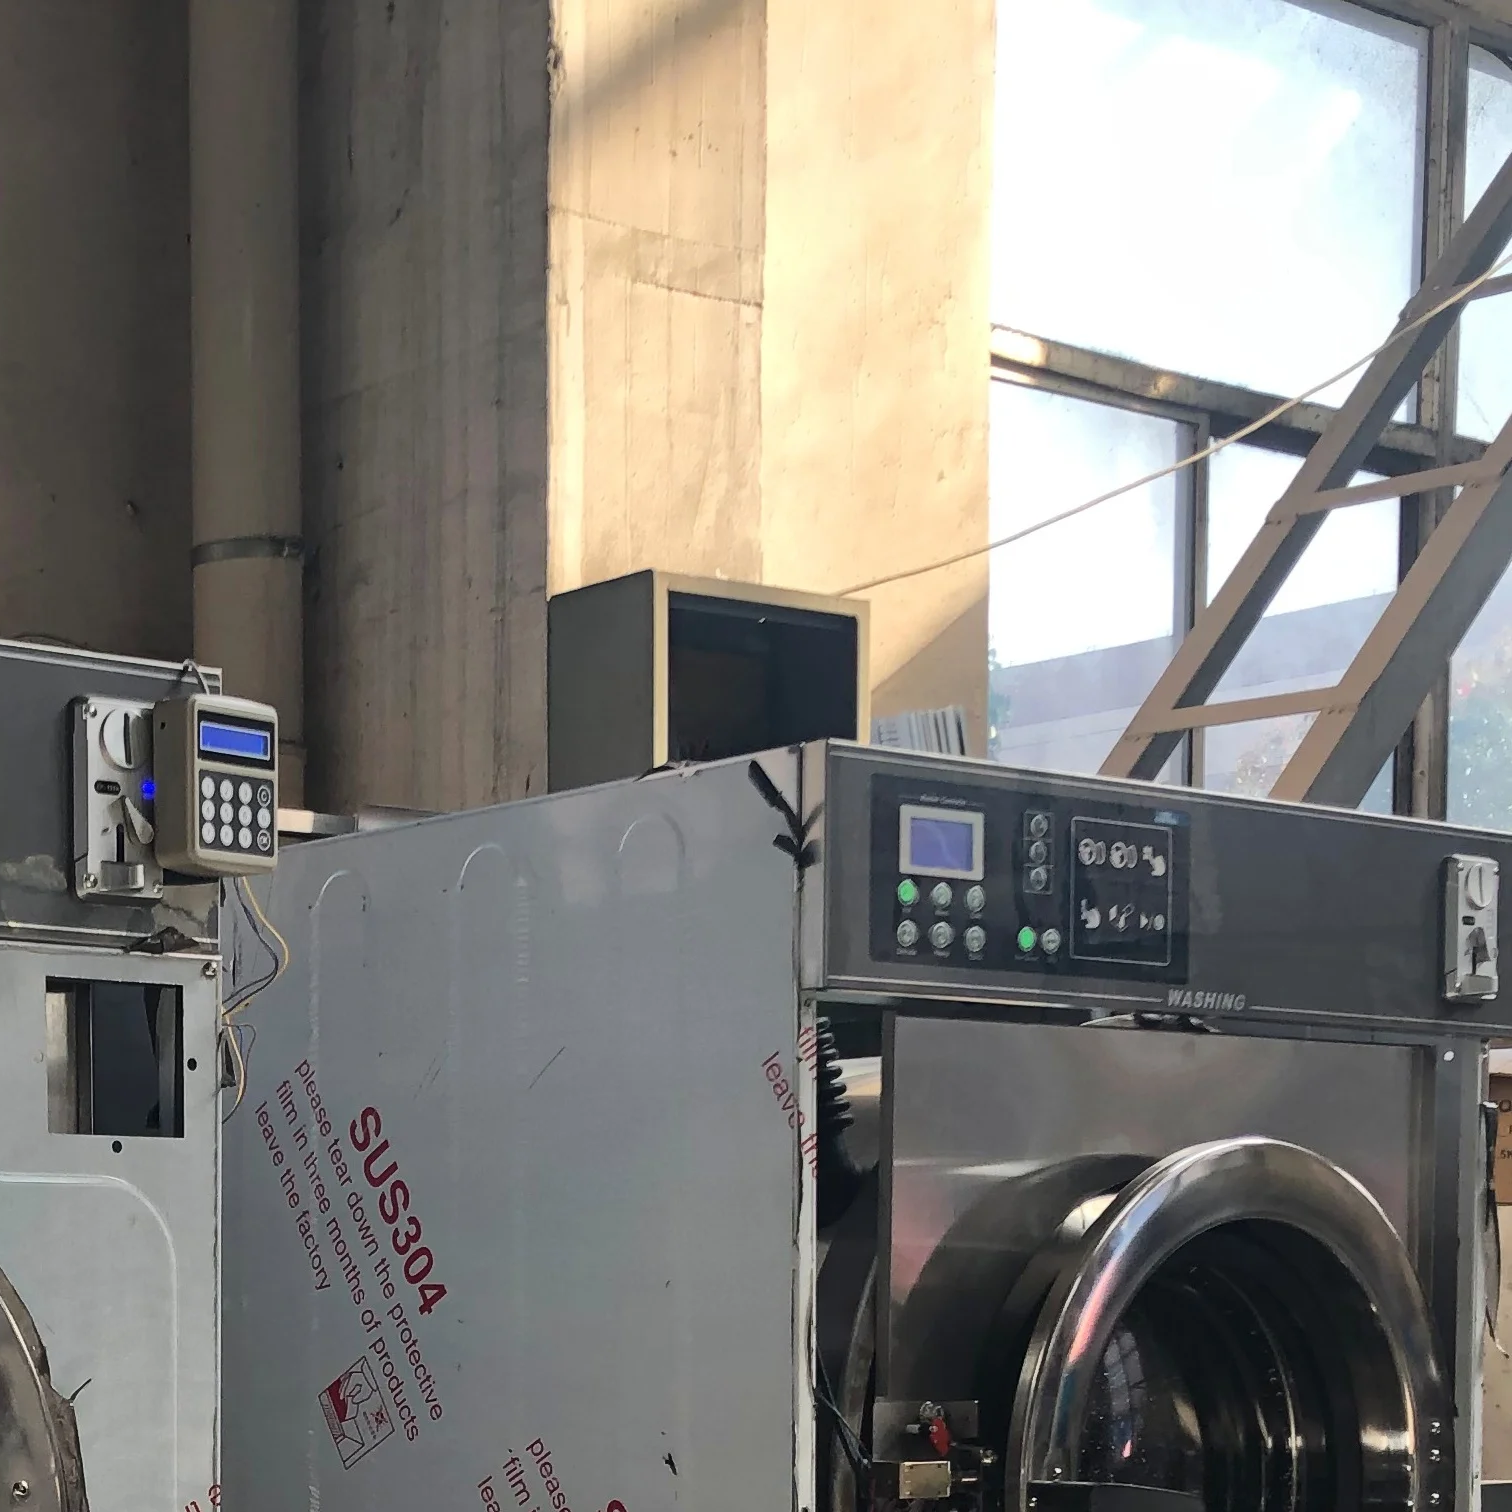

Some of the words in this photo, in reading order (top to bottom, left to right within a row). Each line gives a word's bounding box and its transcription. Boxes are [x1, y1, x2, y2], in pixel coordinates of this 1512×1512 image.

[1168, 988, 1247, 1012] WASHING
[275, 1079, 299, 1122] film
[761, 1050, 806, 1130] leave
[293, 1124, 308, 1152] in
[254, 1101, 285, 1167] leave
[279, 1167, 300, 1209] the
[295, 1210, 332, 1291] factory
[302, 1150, 332, 1215] three
[349, 1106, 448, 1316] SUS304
[294, 1058, 332, 1137] please
[326, 1138, 354, 1187] tear
[346, 1191, 380, 1258] down
[373, 1257, 396, 1299] the
[386, 1301, 443, 1421] protective
[326, 1217, 366, 1306] months
[360, 1308, 381, 1335] of
[368, 1341, 420, 1443] products
[501, 1454, 532, 1506] film
